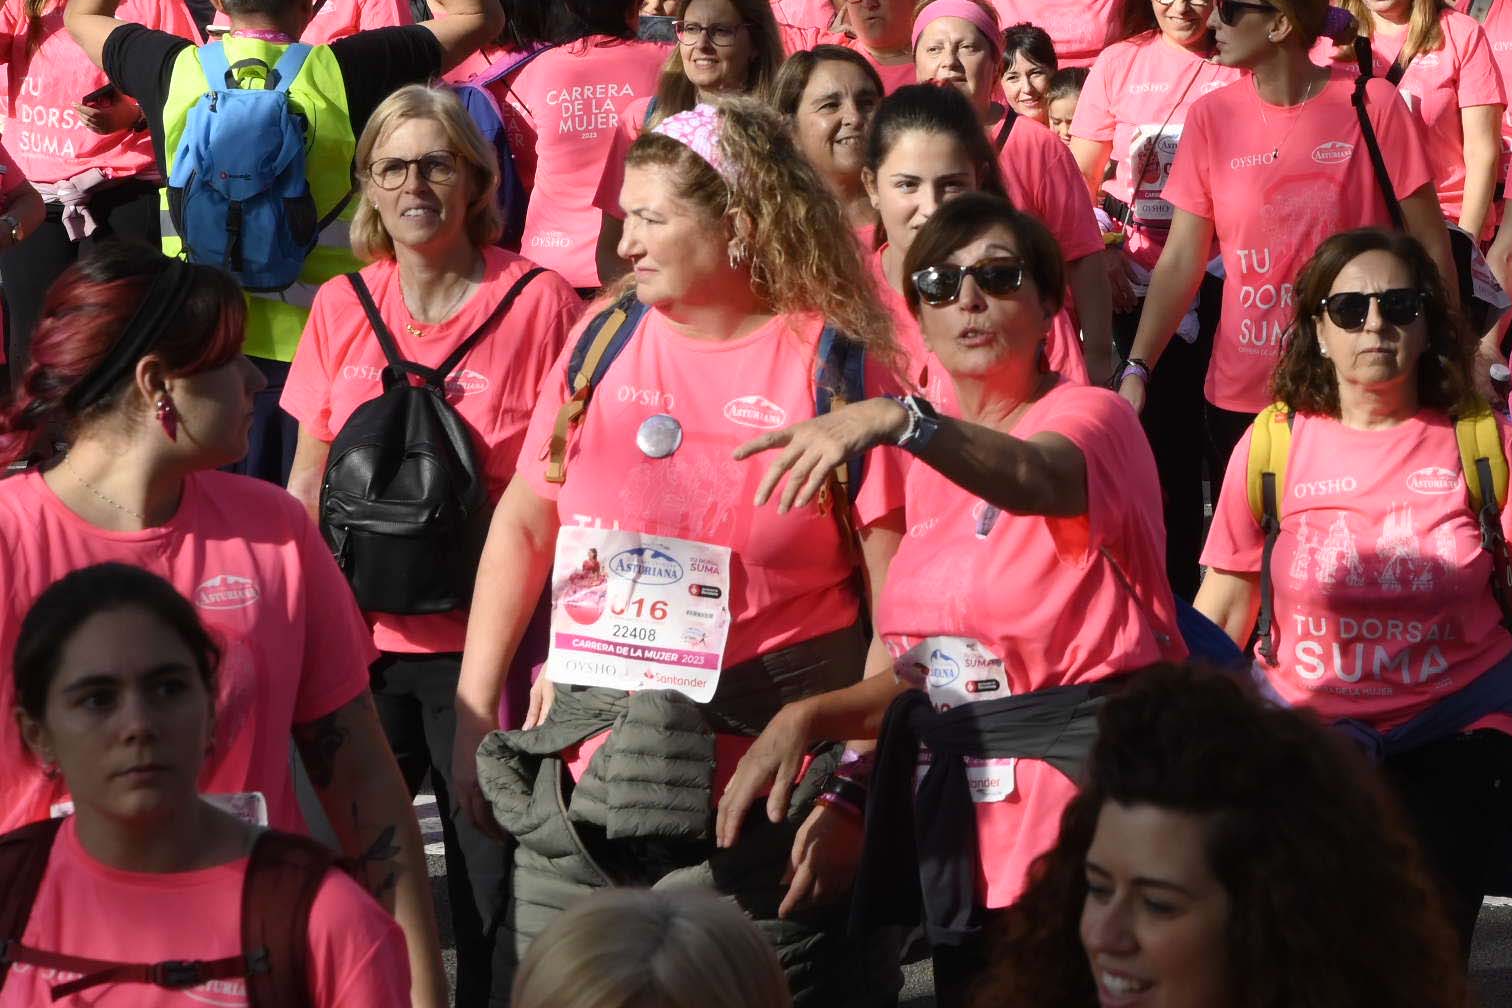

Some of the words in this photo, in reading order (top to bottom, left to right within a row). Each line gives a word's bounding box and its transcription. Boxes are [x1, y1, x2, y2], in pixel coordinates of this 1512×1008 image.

[19, 77, 41, 96] TU
[546, 83, 634, 105] CARRERA
[562, 102, 583, 117] DE
[591, 98, 616, 113] LA
[559, 113, 618, 134] MUJER
[20, 131, 75, 158] SUMA
[1231, 153, 1275, 170] OYSHO
[531, 235, 571, 249] OYSHO
[1237, 248, 1270, 274] TU
[1239, 284, 1295, 310] DOR
[1239, 319, 1295, 346] SUM
[1294, 477, 1357, 498] OYSHO
[616, 558, 678, 579] ASTURIANA
[690, 563, 720, 575] SUMA
[613, 624, 657, 642] 22408
[1293, 614, 1328, 637] TU
[1340, 618, 1456, 641] DORSAL
[572, 638, 615, 653] CARRERA
[616, 645, 629, 656] DE
[630, 647, 643, 658] LA
[644, 649, 679, 662] MUJER
[681, 654, 705, 665] 2023
[1295, 640, 1449, 684] SUMA
[565, 659, 617, 676] OYSHO
[655, 672, 708, 689] Santander
